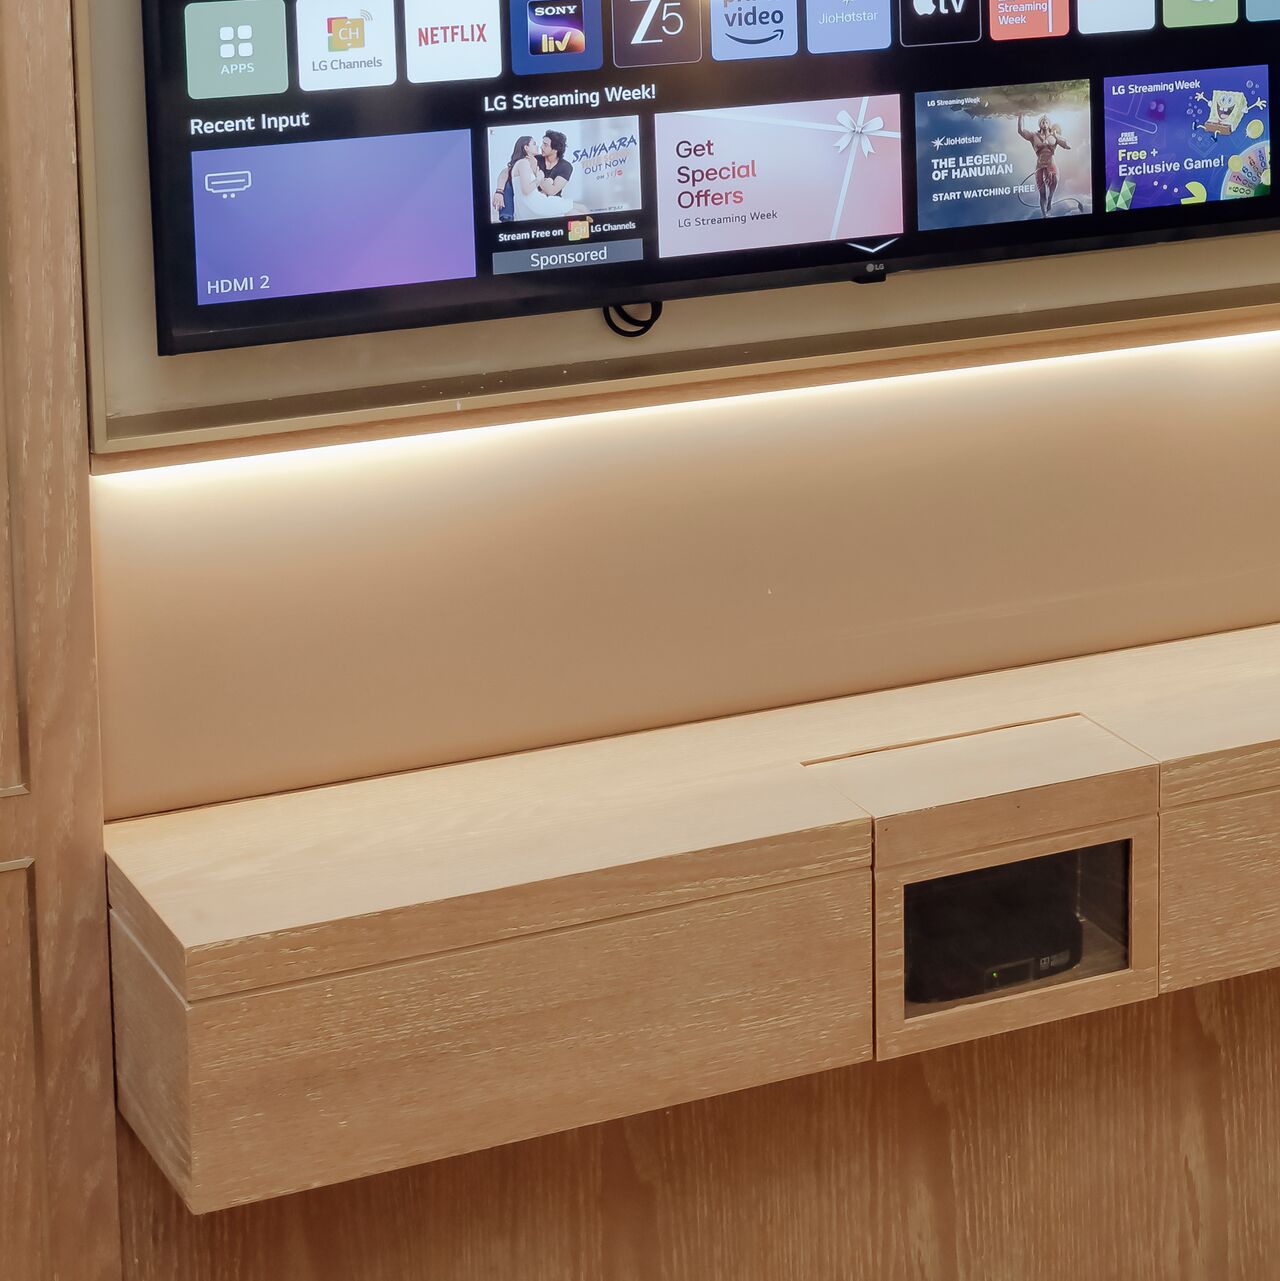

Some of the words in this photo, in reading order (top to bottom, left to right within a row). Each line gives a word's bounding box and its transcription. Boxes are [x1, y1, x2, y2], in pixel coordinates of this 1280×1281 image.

[534, 5, 577, 16] SONY
[998, 0, 1048, 15] Streaming
[723, 7, 784, 28] video
[818, 10, 878, 25] JioHotstar
[998, 14, 1027, 25] Week
[338, 26, 360, 41] CH
[417, 23, 488, 47] NETFLIX
[220, 62, 255, 75] APPS
[311, 60, 328, 72] LG
[330, 56, 383, 71] Channels
[1112, 86, 1126, 95] LG
[1128, 82, 1174, 94] Streaming
[1175, 79, 1200, 89] Week
[484, 95, 507, 112] LG
[512, 89, 600, 109] Streaming
[605, 83, 657, 102] Week!
[927, 99, 936, 107] LG
[936, 97, 965, 107] Streaming
[964, 96, 981, 105] Week
[190, 115, 255, 136] Recent
[261, 111, 310, 132] Input
[572, 134, 638, 163] SAIYAARA
[675, 139, 714, 158] Get
[943, 136, 983, 147] JioHotstar
[931, 158, 956, 169] THE
[959, 153, 1008, 167] LEGEND
[1118, 149, 1147, 161] Free
[584, 163, 603, 175] OUT
[604, 156, 627, 169] NOW
[677, 160, 757, 187] Special
[931, 170, 948, 181] OF
[951, 163, 1014, 179] HANUMAN
[1119, 160, 1180, 177] Exclusive
[1184, 155, 1224, 170] Game!
[677, 189, 744, 209] Offers
[932, 192, 961, 202] START
[963, 187, 1011, 199] WATCHING
[1013, 184, 1036, 193] FREE
[590, 224, 602, 233] LG
[602, 221, 636, 232] Channels
[678, 218, 692, 228] LG
[695, 213, 747, 227] Streaming
[749, 210, 778, 221] Week
[498, 232, 530, 241] Stream
[531, 230, 550, 239] Free
[530, 246, 607, 270] Sponsored
[207, 277, 254, 294] HDMI
[259, 275, 271, 289] 2
